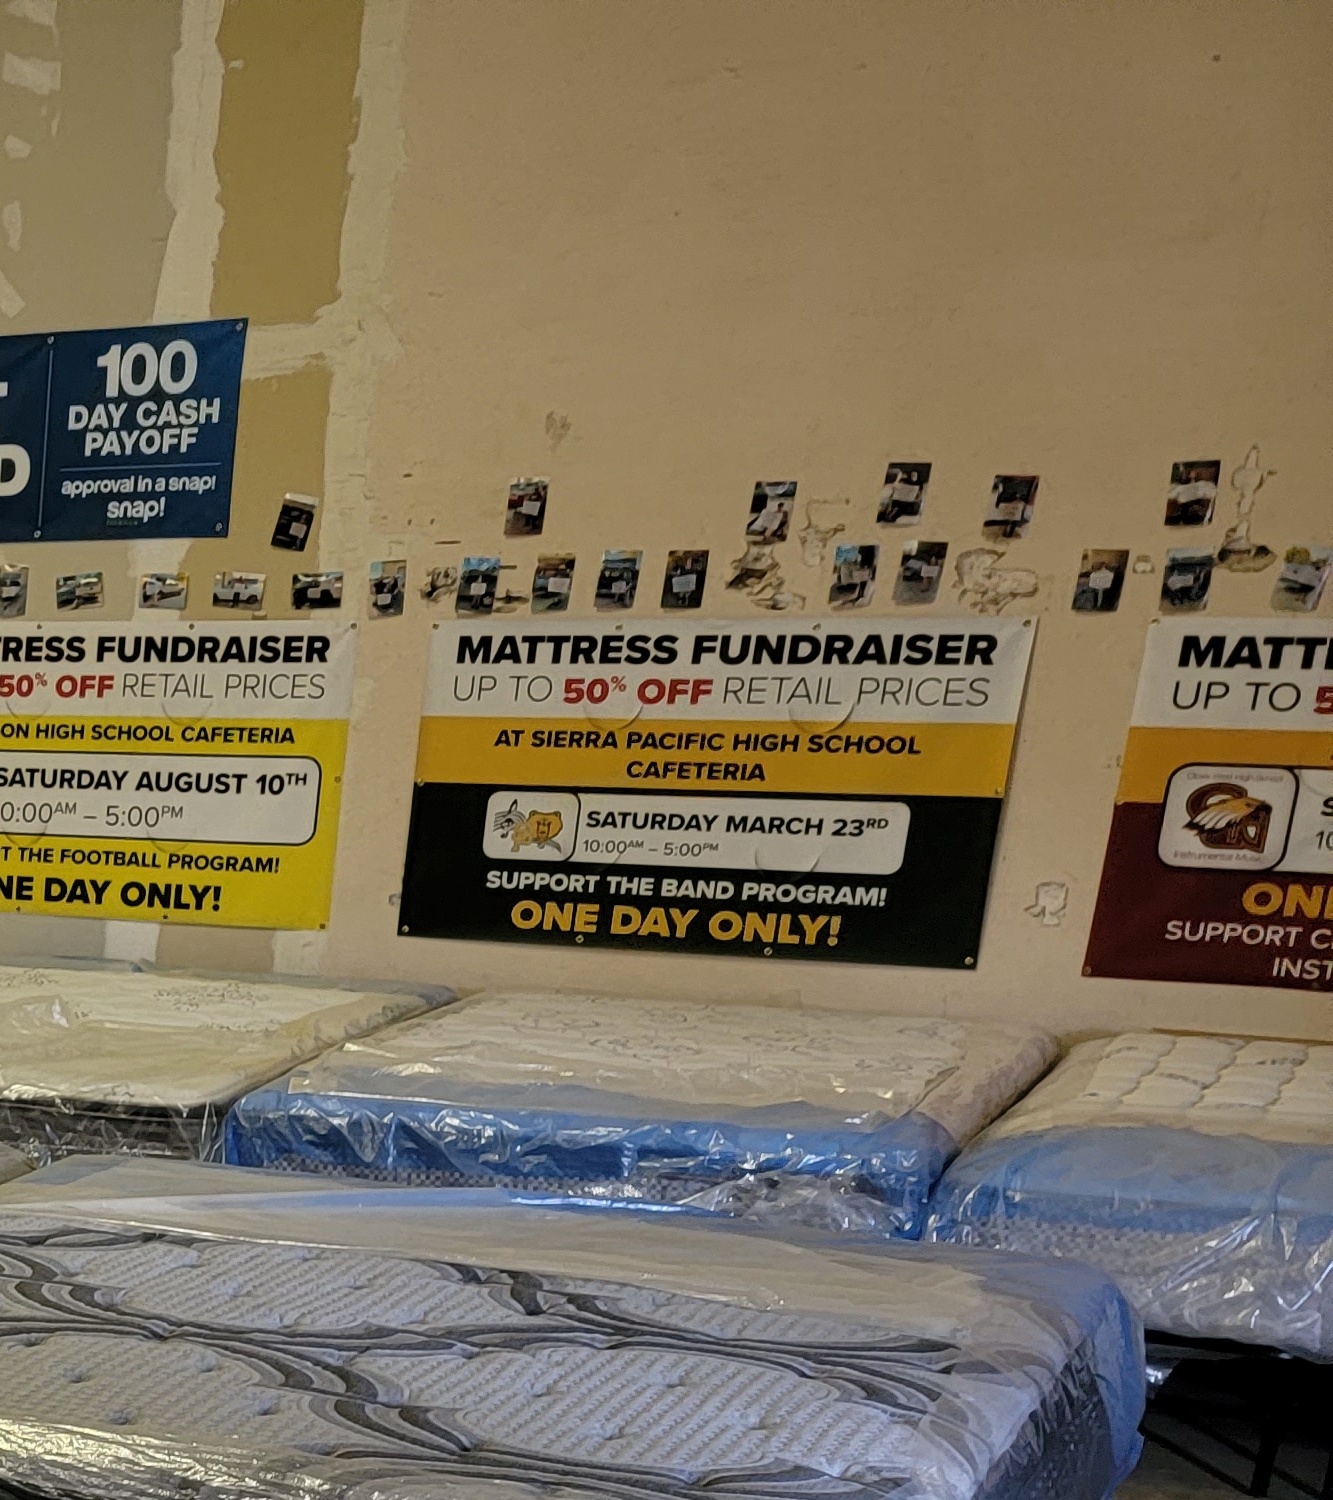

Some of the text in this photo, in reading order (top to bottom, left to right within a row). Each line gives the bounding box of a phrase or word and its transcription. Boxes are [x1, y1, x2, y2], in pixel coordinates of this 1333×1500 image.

[96, 341, 197, 397] 100
[67, 398, 220, 431] DAY CASH
[84, 428, 197, 457] PAYOFF
[61, 475, 216, 498] approval in a snap!
[107, 496, 166, 523] snap!
[96, 635, 331, 664] FUNDRAISER
[456, 634, 998, 666] MATTRESS FUNDRAISER
[54, 675, 114, 698] OFF
[122, 673, 213, 699] RETAIL
[223, 673, 326, 700] PRICES
[453, 675, 990, 707] UP TO 50% OFF RETAIL PRICES
[1173, 681, 1301, 712] UP TO
[36, 723, 86, 741] HIGH
[90, 724, 175, 742] SCHOOL
[180, 726, 295, 745] CAFETERIA
[493, 729, 922, 755] AT SIERRA PACIFIC HIGH SCHOOL
[135, 772, 248, 795] AUGUST
[255, 772, 308, 796] 10TH
[625, 761, 766, 782] CAFETERIA
[105, 805, 184, 828] 5:00PM
[585, 810, 889, 839] SATURDAY MARCH 23RD
[18, 846, 54, 864] THE
[59, 849, 162, 869] FOOTBALL
[167, 854, 280, 873] PROGRAM!
[583, 838, 719, 858] 10:00AM 5:00PM
[44, 877, 113, 905] DAY
[120, 880, 222, 911] ONLY!
[485, 870, 887, 908] SUPPORT THE BAND PROGRAM!
[510, 899, 842, 947] ONE DAY ONLY!
[1165, 919, 1303, 948] SUPPORT
